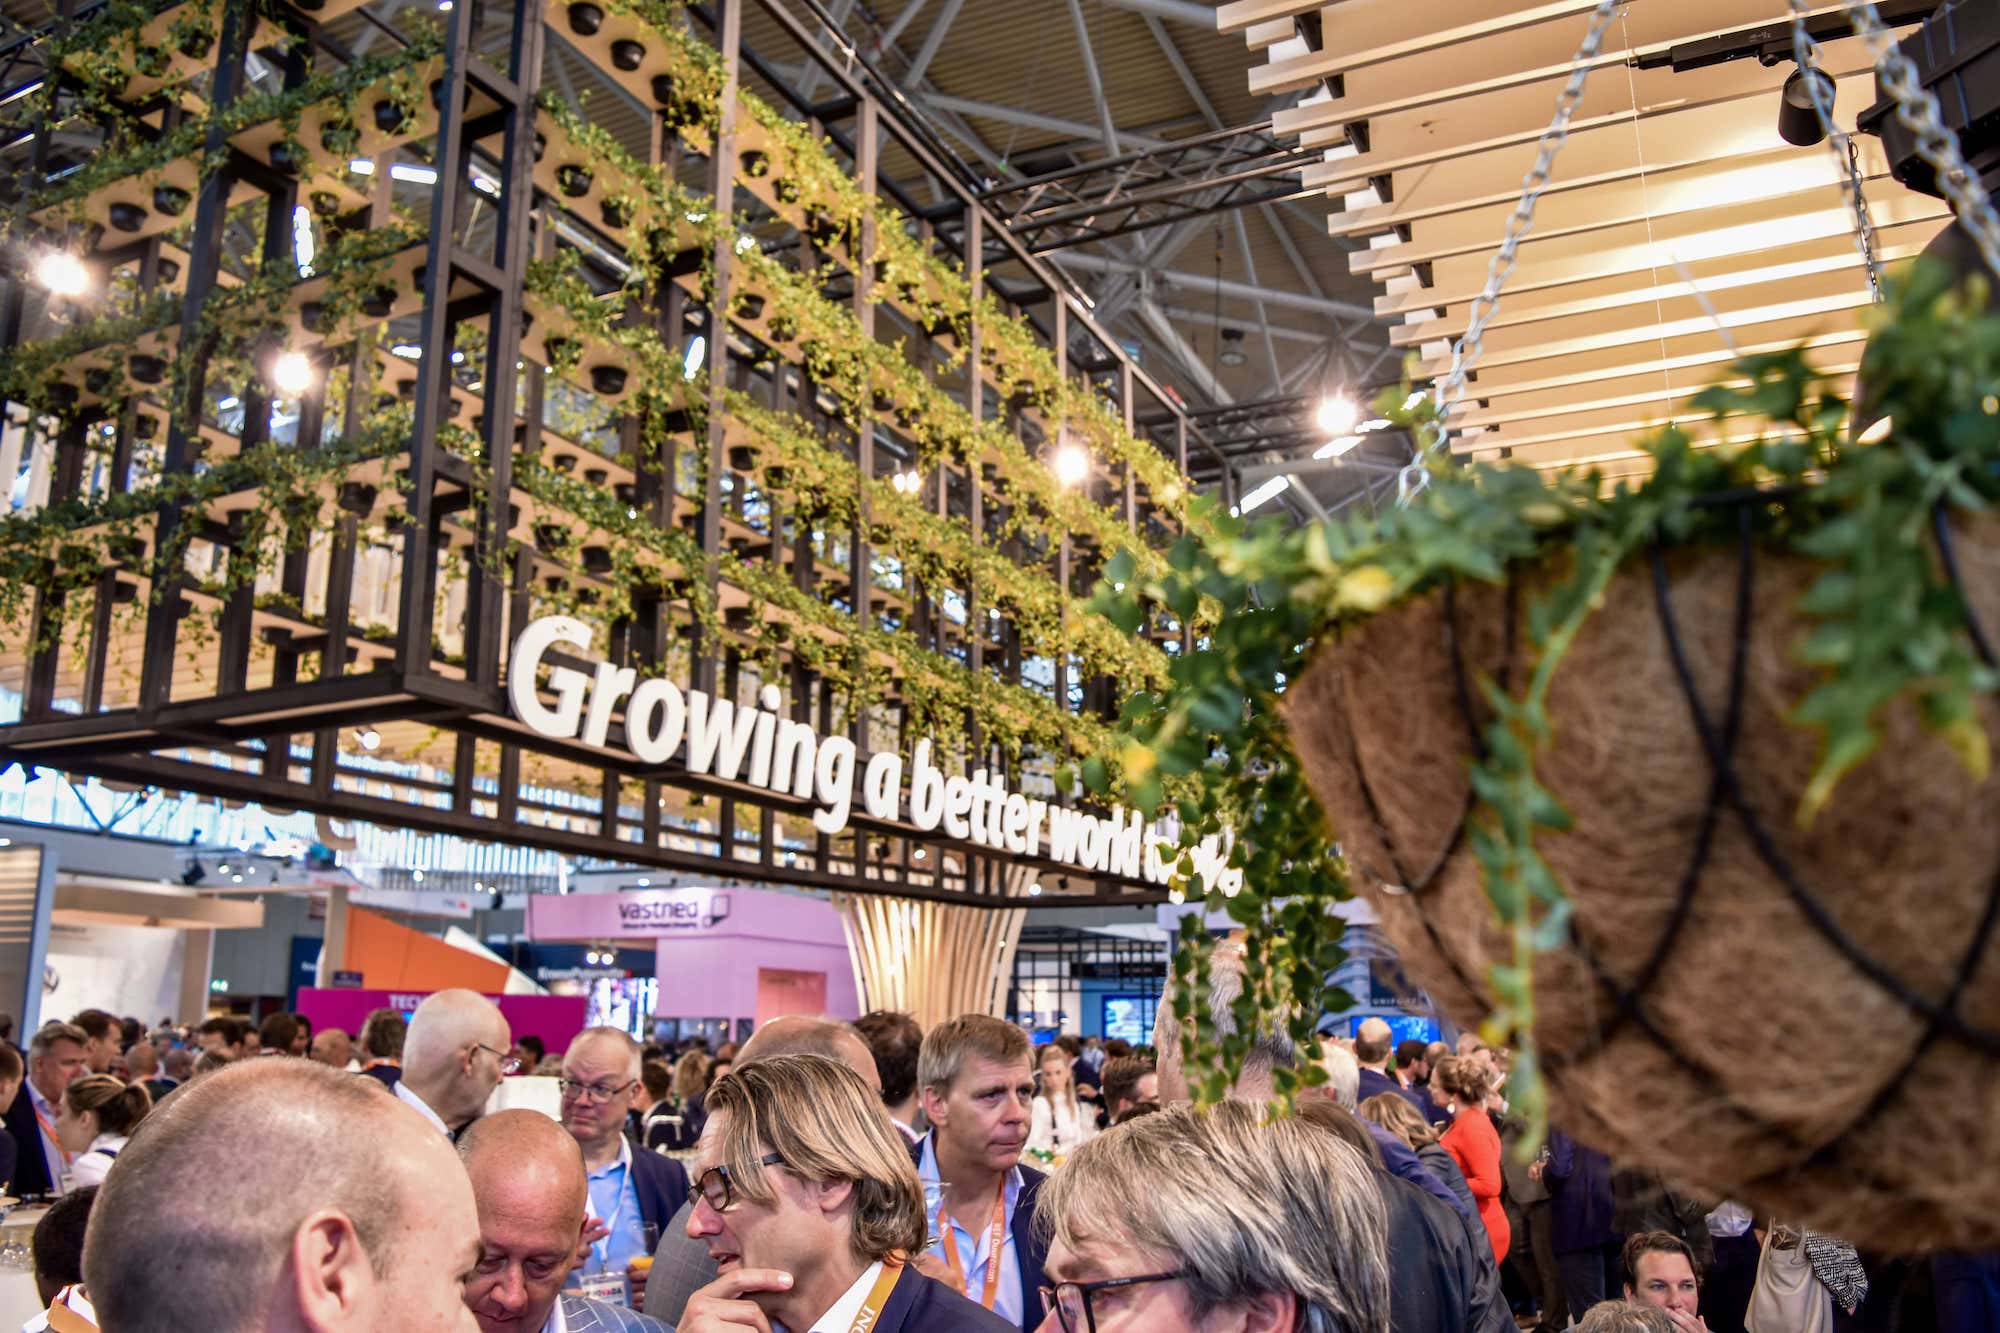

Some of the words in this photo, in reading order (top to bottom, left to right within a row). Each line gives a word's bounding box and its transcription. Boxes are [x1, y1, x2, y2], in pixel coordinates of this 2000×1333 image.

[508, 615, 856, 834] Growing
[863, 752, 902, 821] a
[910, 737, 1046, 856] better
[1050, 803, 1142, 878] world
[618, 901, 698, 919] vastned
